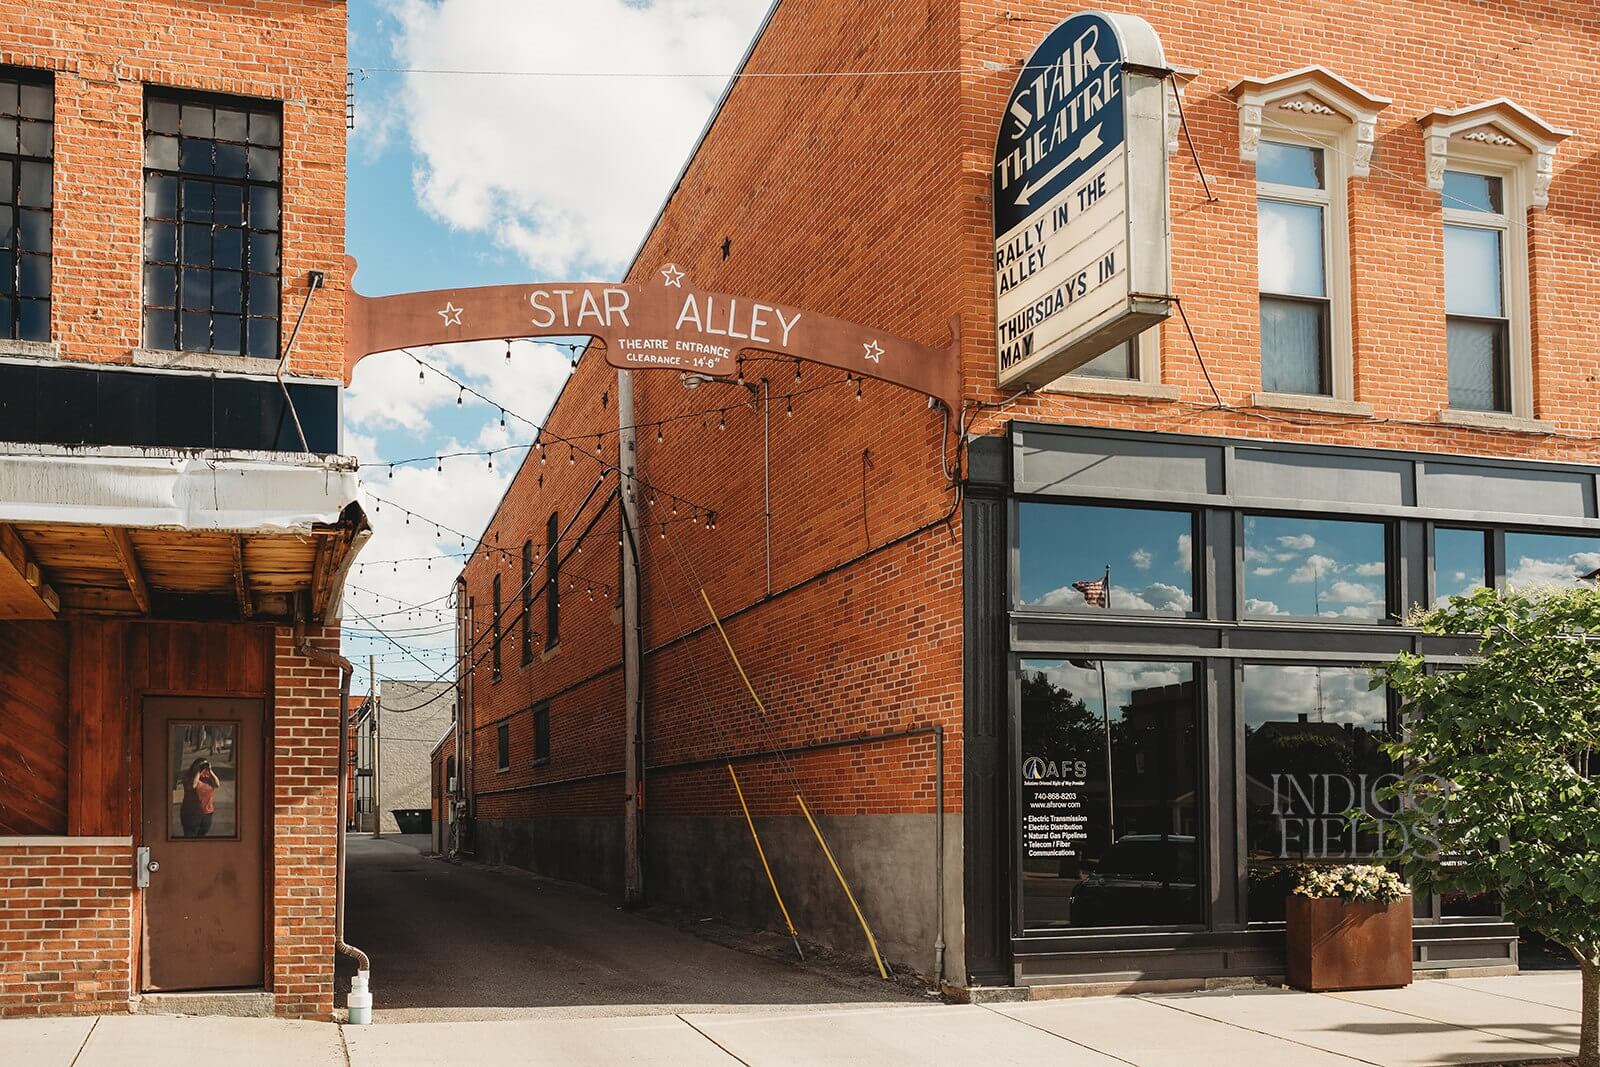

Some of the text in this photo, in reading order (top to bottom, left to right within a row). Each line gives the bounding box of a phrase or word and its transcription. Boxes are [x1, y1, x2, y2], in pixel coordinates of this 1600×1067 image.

[1010, 25, 1102, 139] STAR
[997, 59, 1120, 190] THEATRE
[996, 172, 1106, 271] RALLY IN THE
[999, 245, 1046, 295] ALLEY
[529, 288, 802, 347] STAR ALLEY
[999, 252, 1115, 344] THURSDAYS IN
[618, 339, 731, 359] THEATRE ENTRANCE
[626, 353, 681, 365] CLEARANCE
[1001, 332, 1034, 371] MAY
[1046, 760, 1087, 778] AFS
[1050, 823, 1083, 831] Distribution
[1061, 832, 1088, 840] Pipelines
[1028, 849, 1076, 857] Communications
